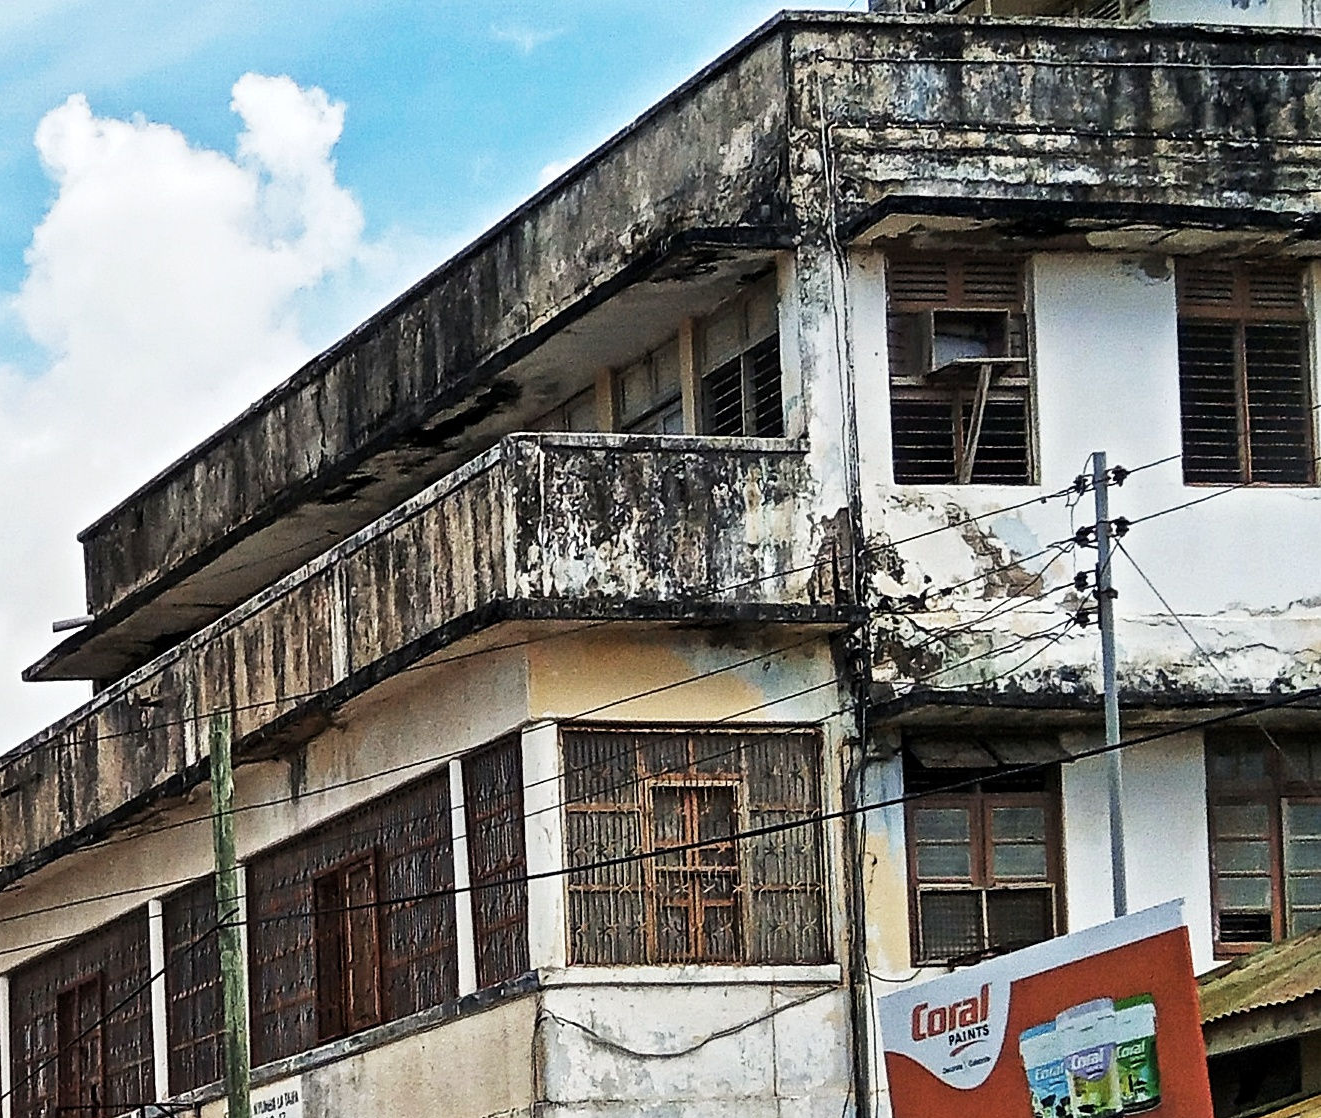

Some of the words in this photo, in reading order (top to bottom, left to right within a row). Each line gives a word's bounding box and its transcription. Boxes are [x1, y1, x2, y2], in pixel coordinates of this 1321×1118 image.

[912, 983, 990, 1042] Coral
[949, 1024, 990, 1046] PAINTS
[1071, 1049, 1104, 1070] Coral
